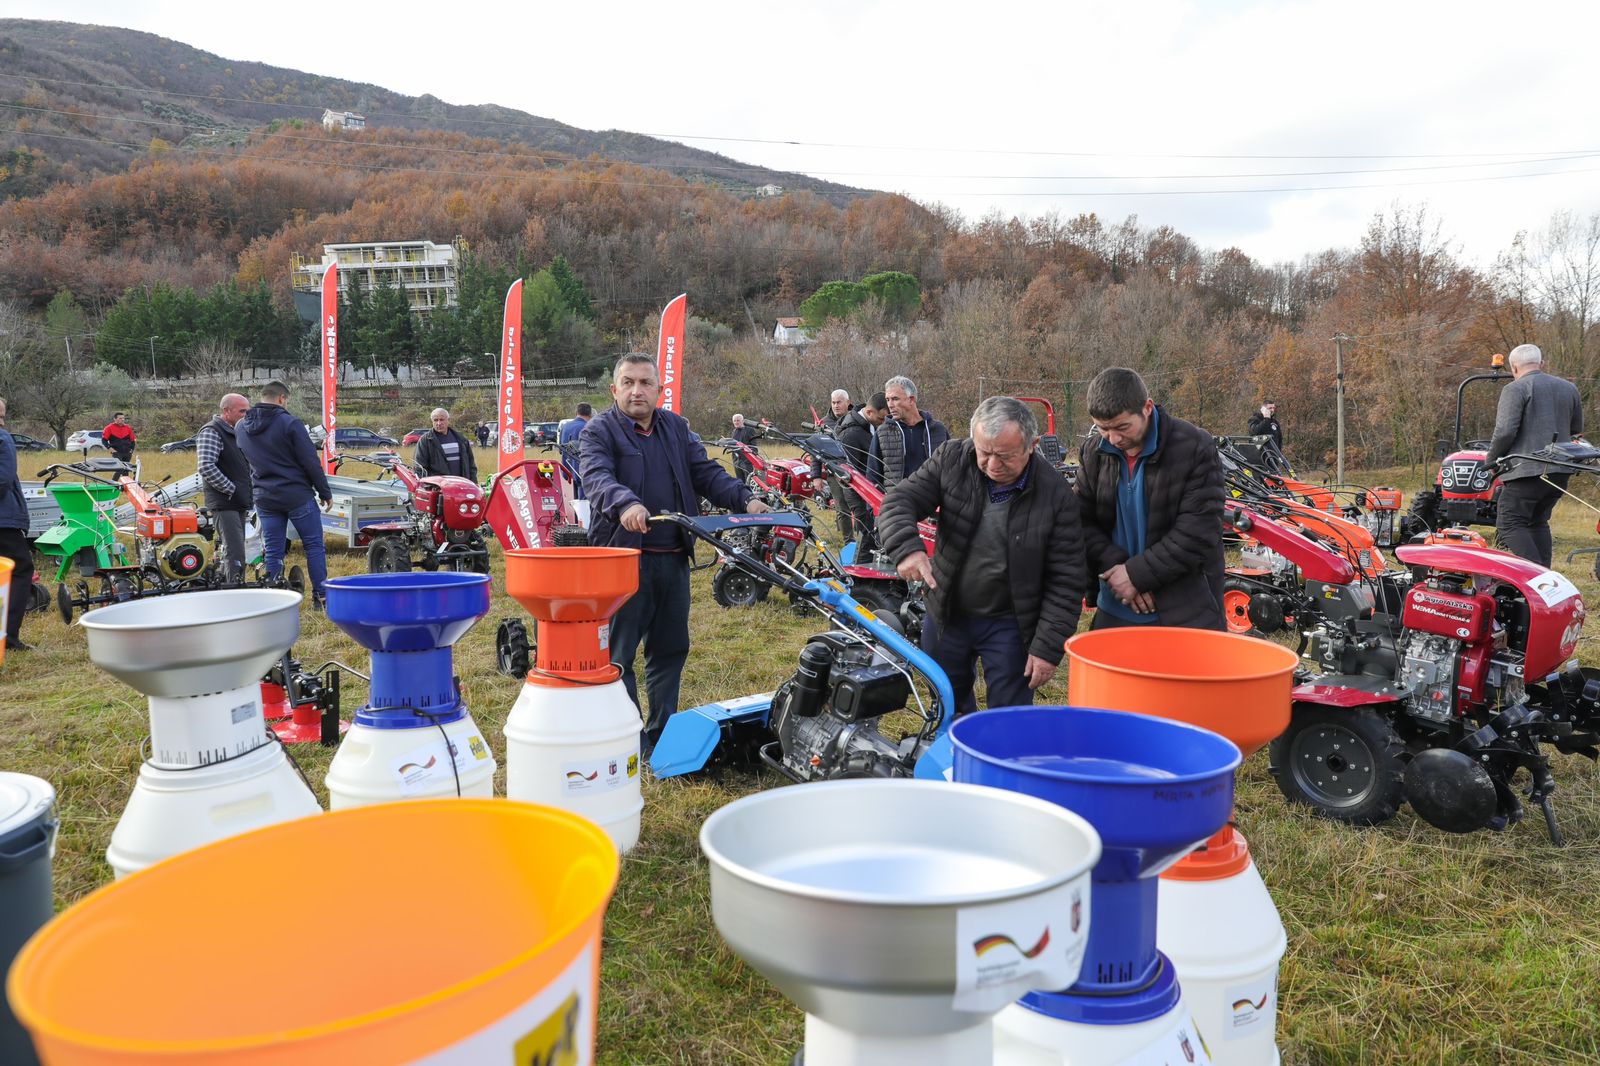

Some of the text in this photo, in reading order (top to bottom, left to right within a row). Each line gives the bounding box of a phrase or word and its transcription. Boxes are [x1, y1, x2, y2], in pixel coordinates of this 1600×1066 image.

[518, 499, 534, 529] Agro
[1424, 595, 1474, 611] Agro Alaska
